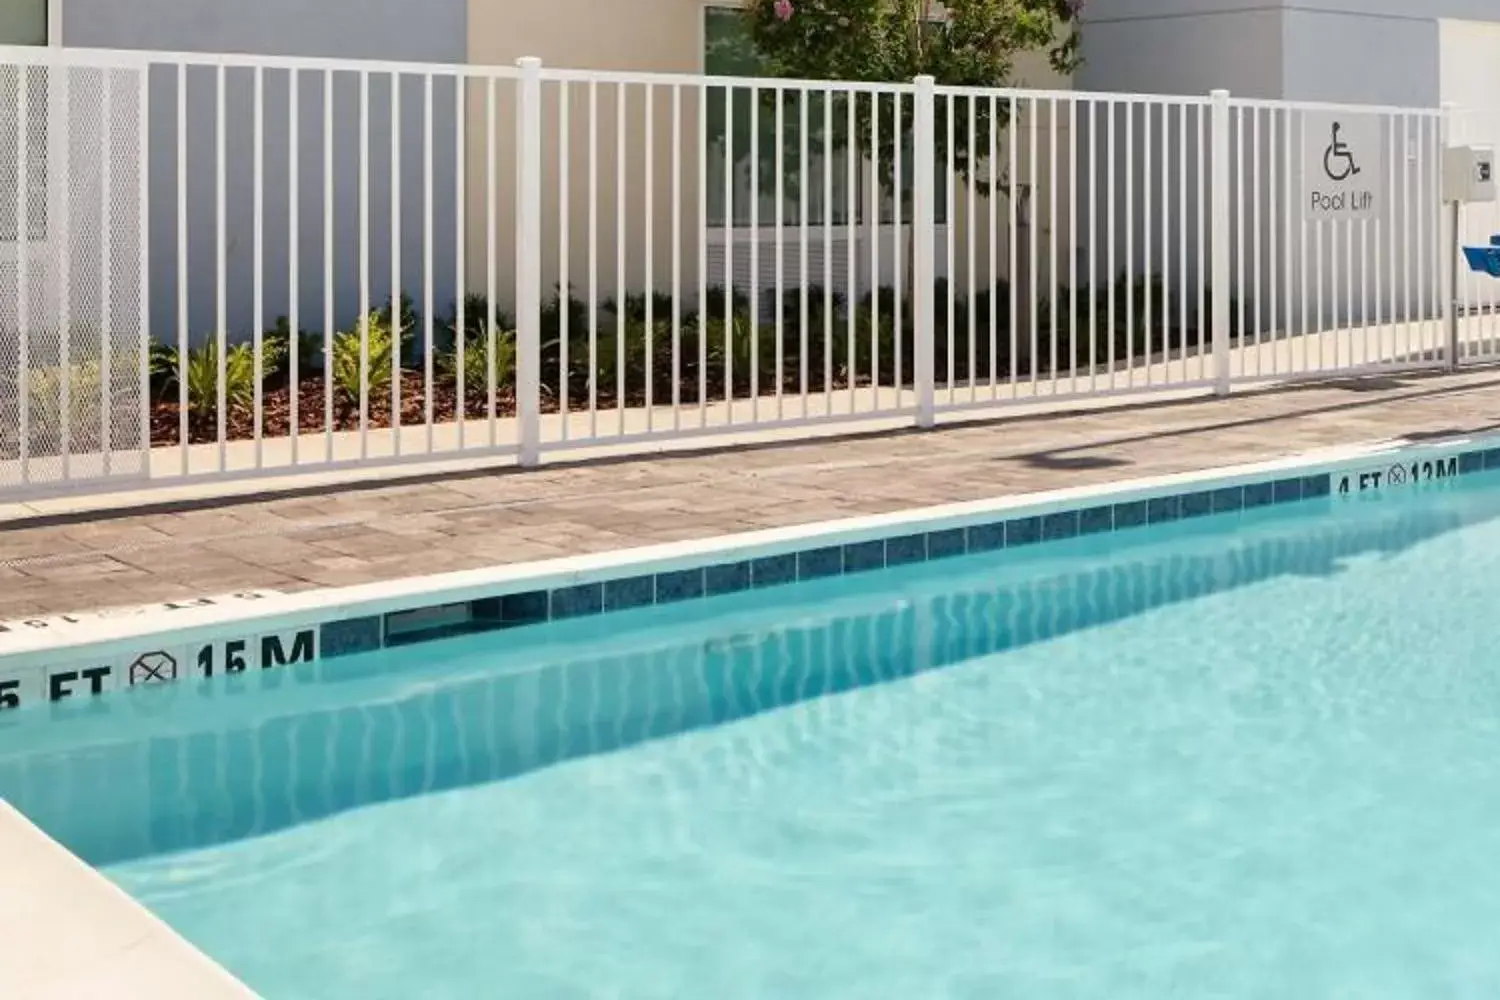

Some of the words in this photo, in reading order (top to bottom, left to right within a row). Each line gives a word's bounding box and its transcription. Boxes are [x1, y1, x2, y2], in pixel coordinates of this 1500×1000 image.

[1311, 191, 1346, 212] Pool
[1351, 191, 1374, 211] Lift
[1360, 471, 1382, 490] FT
[49, 665, 112, 702] FT
